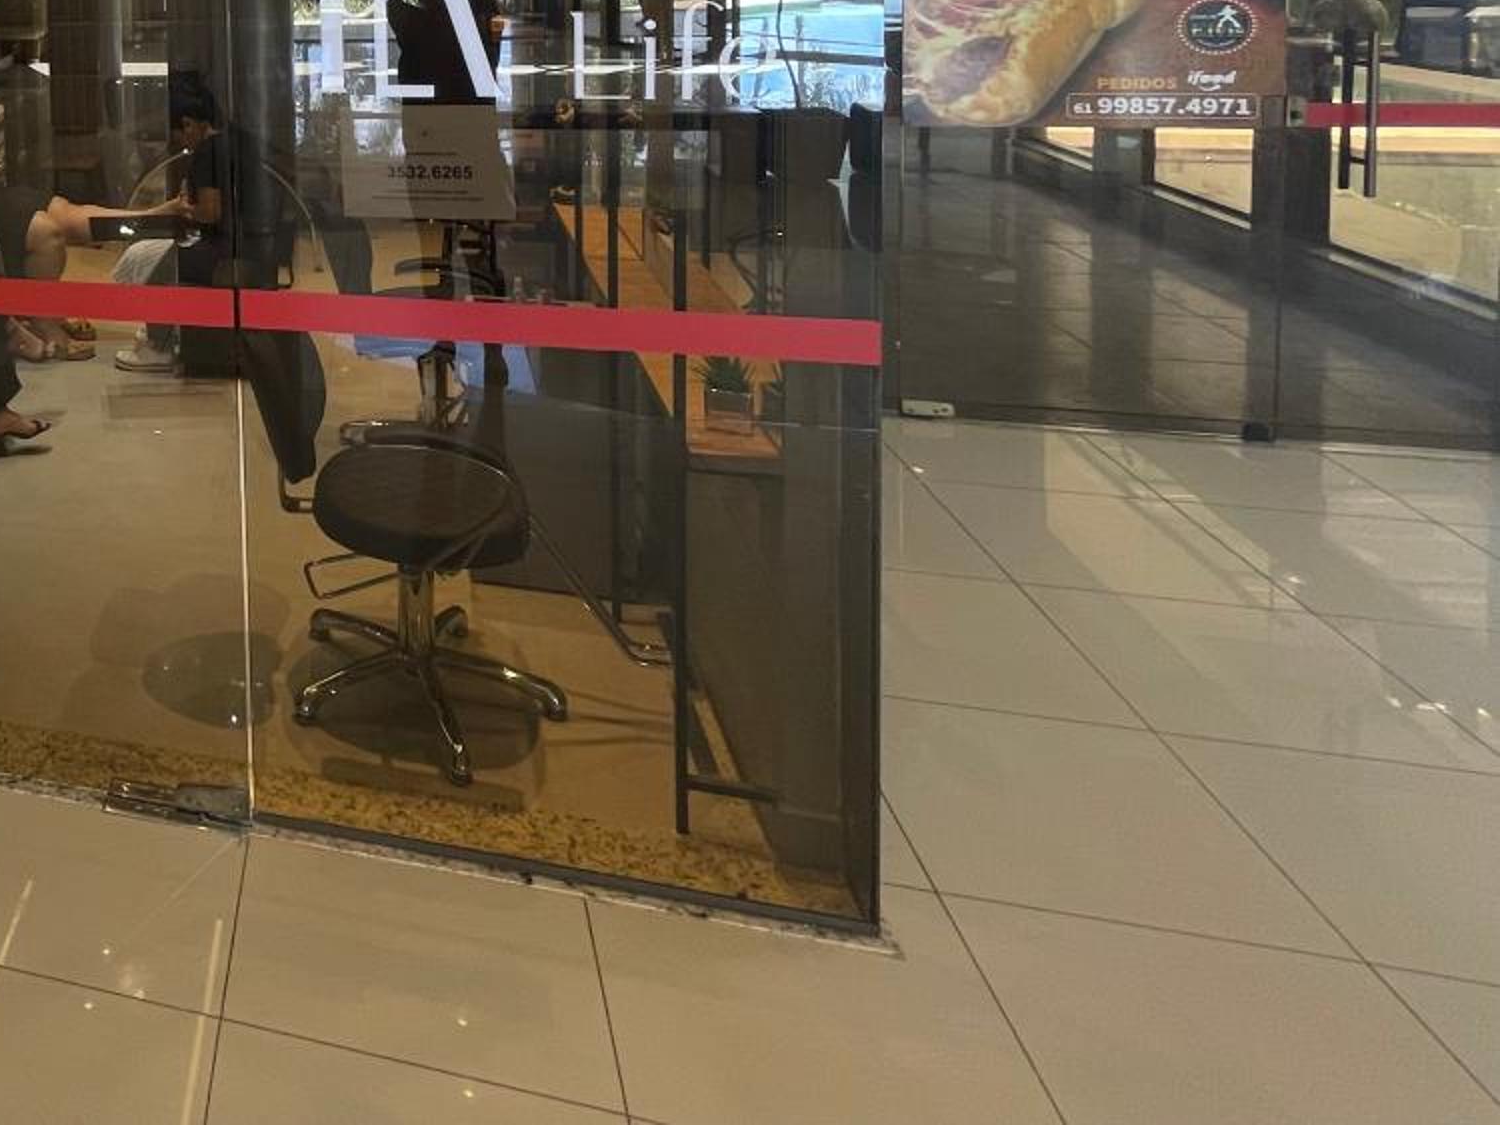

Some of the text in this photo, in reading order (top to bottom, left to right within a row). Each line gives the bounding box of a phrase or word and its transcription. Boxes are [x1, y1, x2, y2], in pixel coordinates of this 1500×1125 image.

[1097, 76, 1178, 90] PEDIDOS
[1073, 97, 1251, 115] 61 99857.4971
